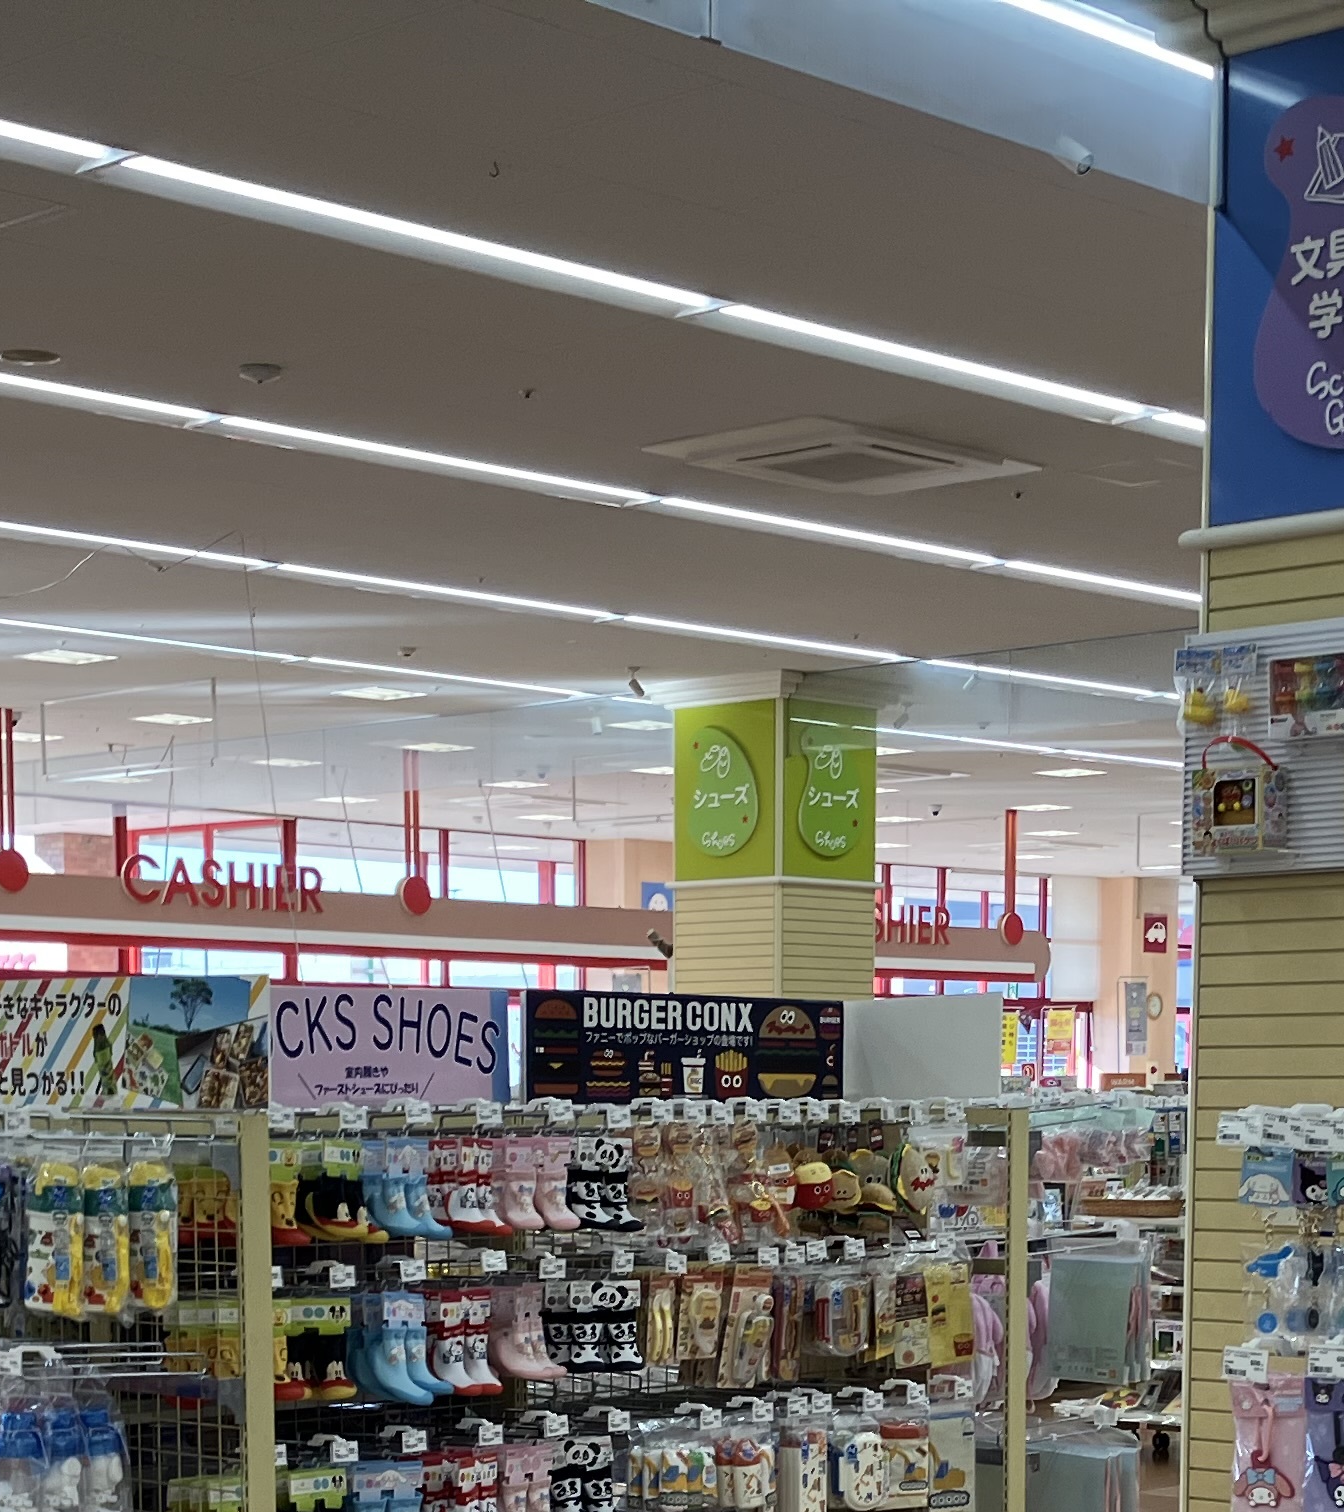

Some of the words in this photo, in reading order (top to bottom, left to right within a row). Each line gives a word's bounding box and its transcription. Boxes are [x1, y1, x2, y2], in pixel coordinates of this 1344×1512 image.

[693, 783, 750, 809] シューズ
[808, 785, 860, 809] シューズ
[701, 831, 736, 850] Shoes
[814, 830, 847, 850] Shoes
[120, 853, 323, 913] CASHIER
[583, 996, 683, 1031] BURGER
[685, 1001, 754, 1033] CONX
[271, 993, 357, 1059] CKS
[372, 993, 500, 1075] SHOES
